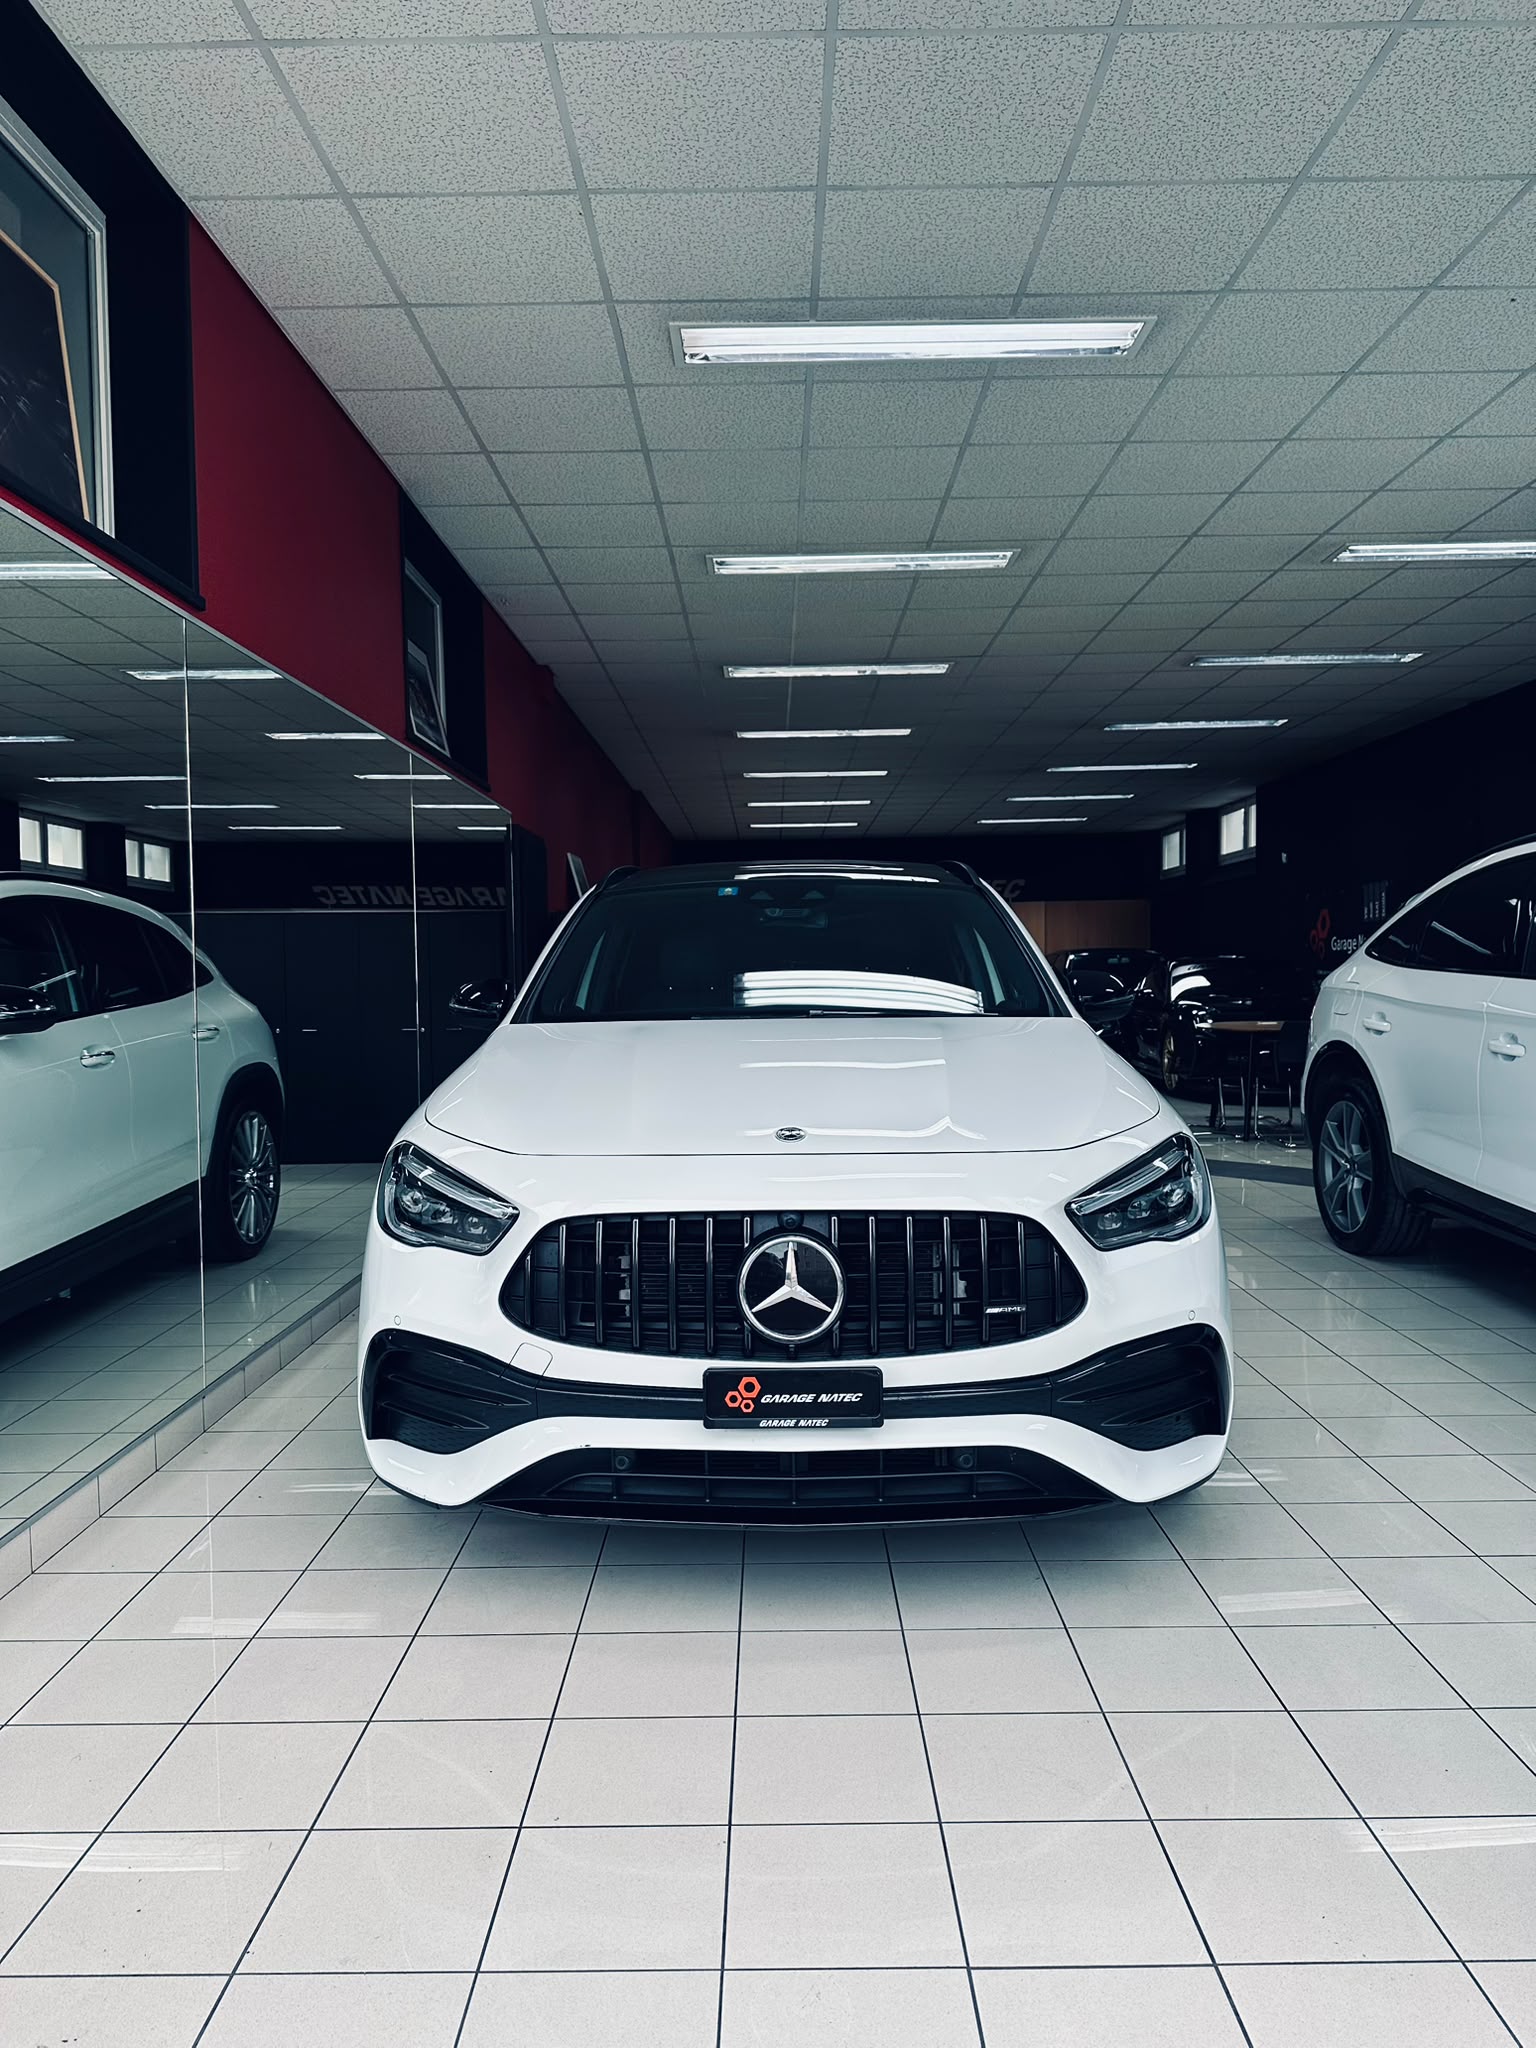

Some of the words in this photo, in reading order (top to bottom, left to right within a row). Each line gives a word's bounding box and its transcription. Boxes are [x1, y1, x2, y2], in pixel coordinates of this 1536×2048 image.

[1331, 936, 1358, 954] Garage
[761, 1393, 814, 1403] GARAGE
[818, 1392, 863, 1403] NATEC
[759, 1419, 795, 1428] GARAGE
[798, 1419, 829, 1427] NATEC
